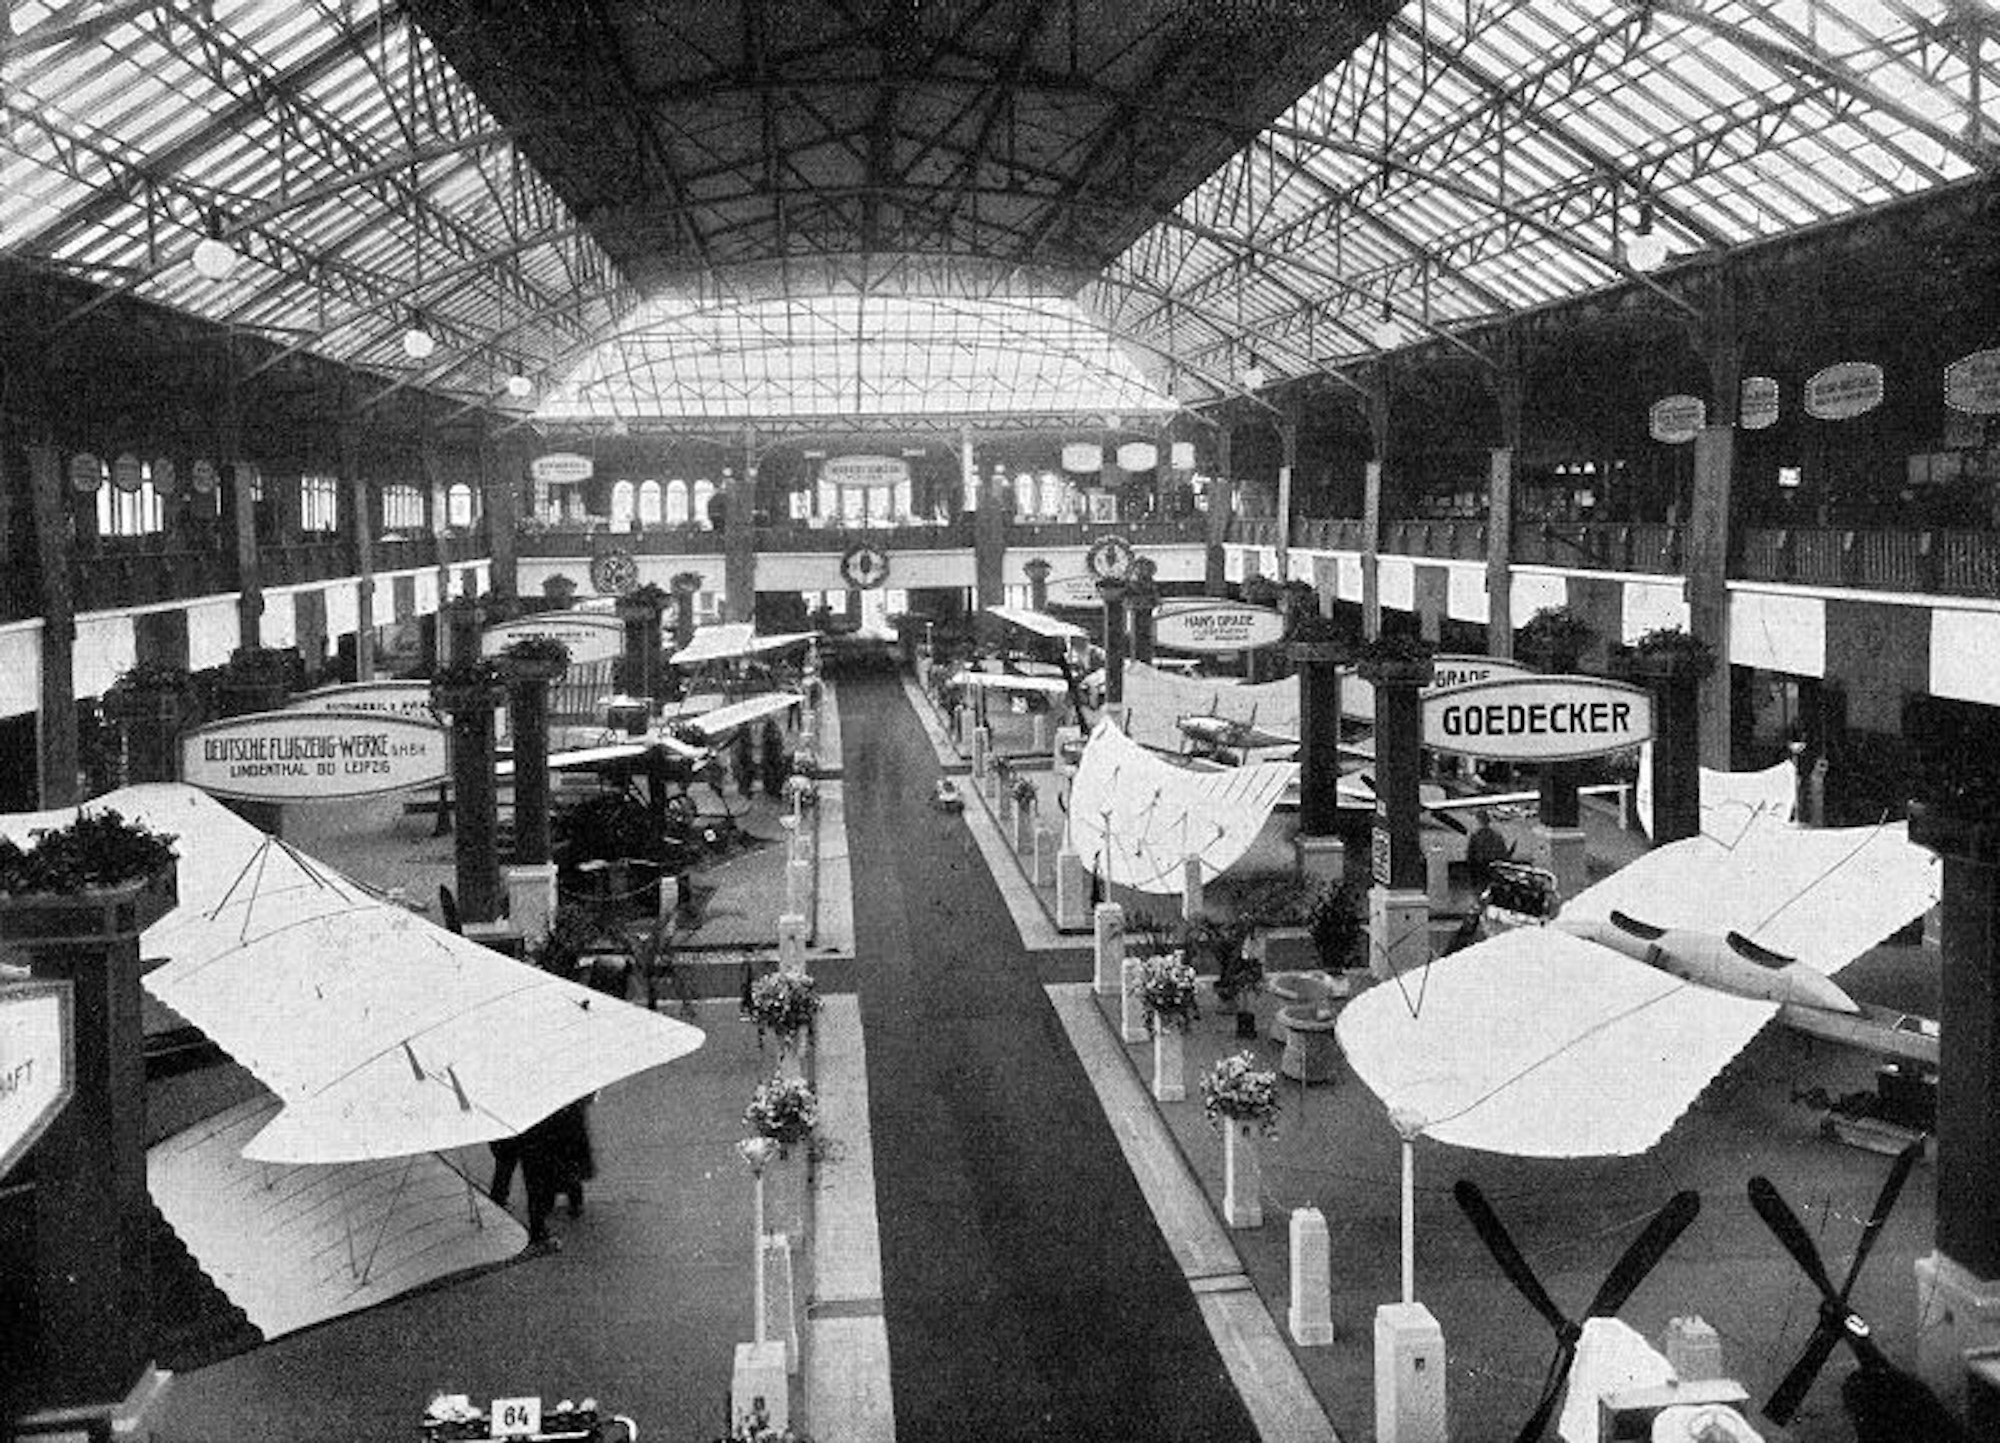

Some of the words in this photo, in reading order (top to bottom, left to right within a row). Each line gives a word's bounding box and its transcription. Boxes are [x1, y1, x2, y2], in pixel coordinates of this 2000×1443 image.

[1443, 703, 1630, 735] GOEDECKER
[205, 738, 268, 761] DEUTSCHE
[230, 763, 309, 778] LINDENTHAL
[345, 760, 390, 773] LEIPZIG
